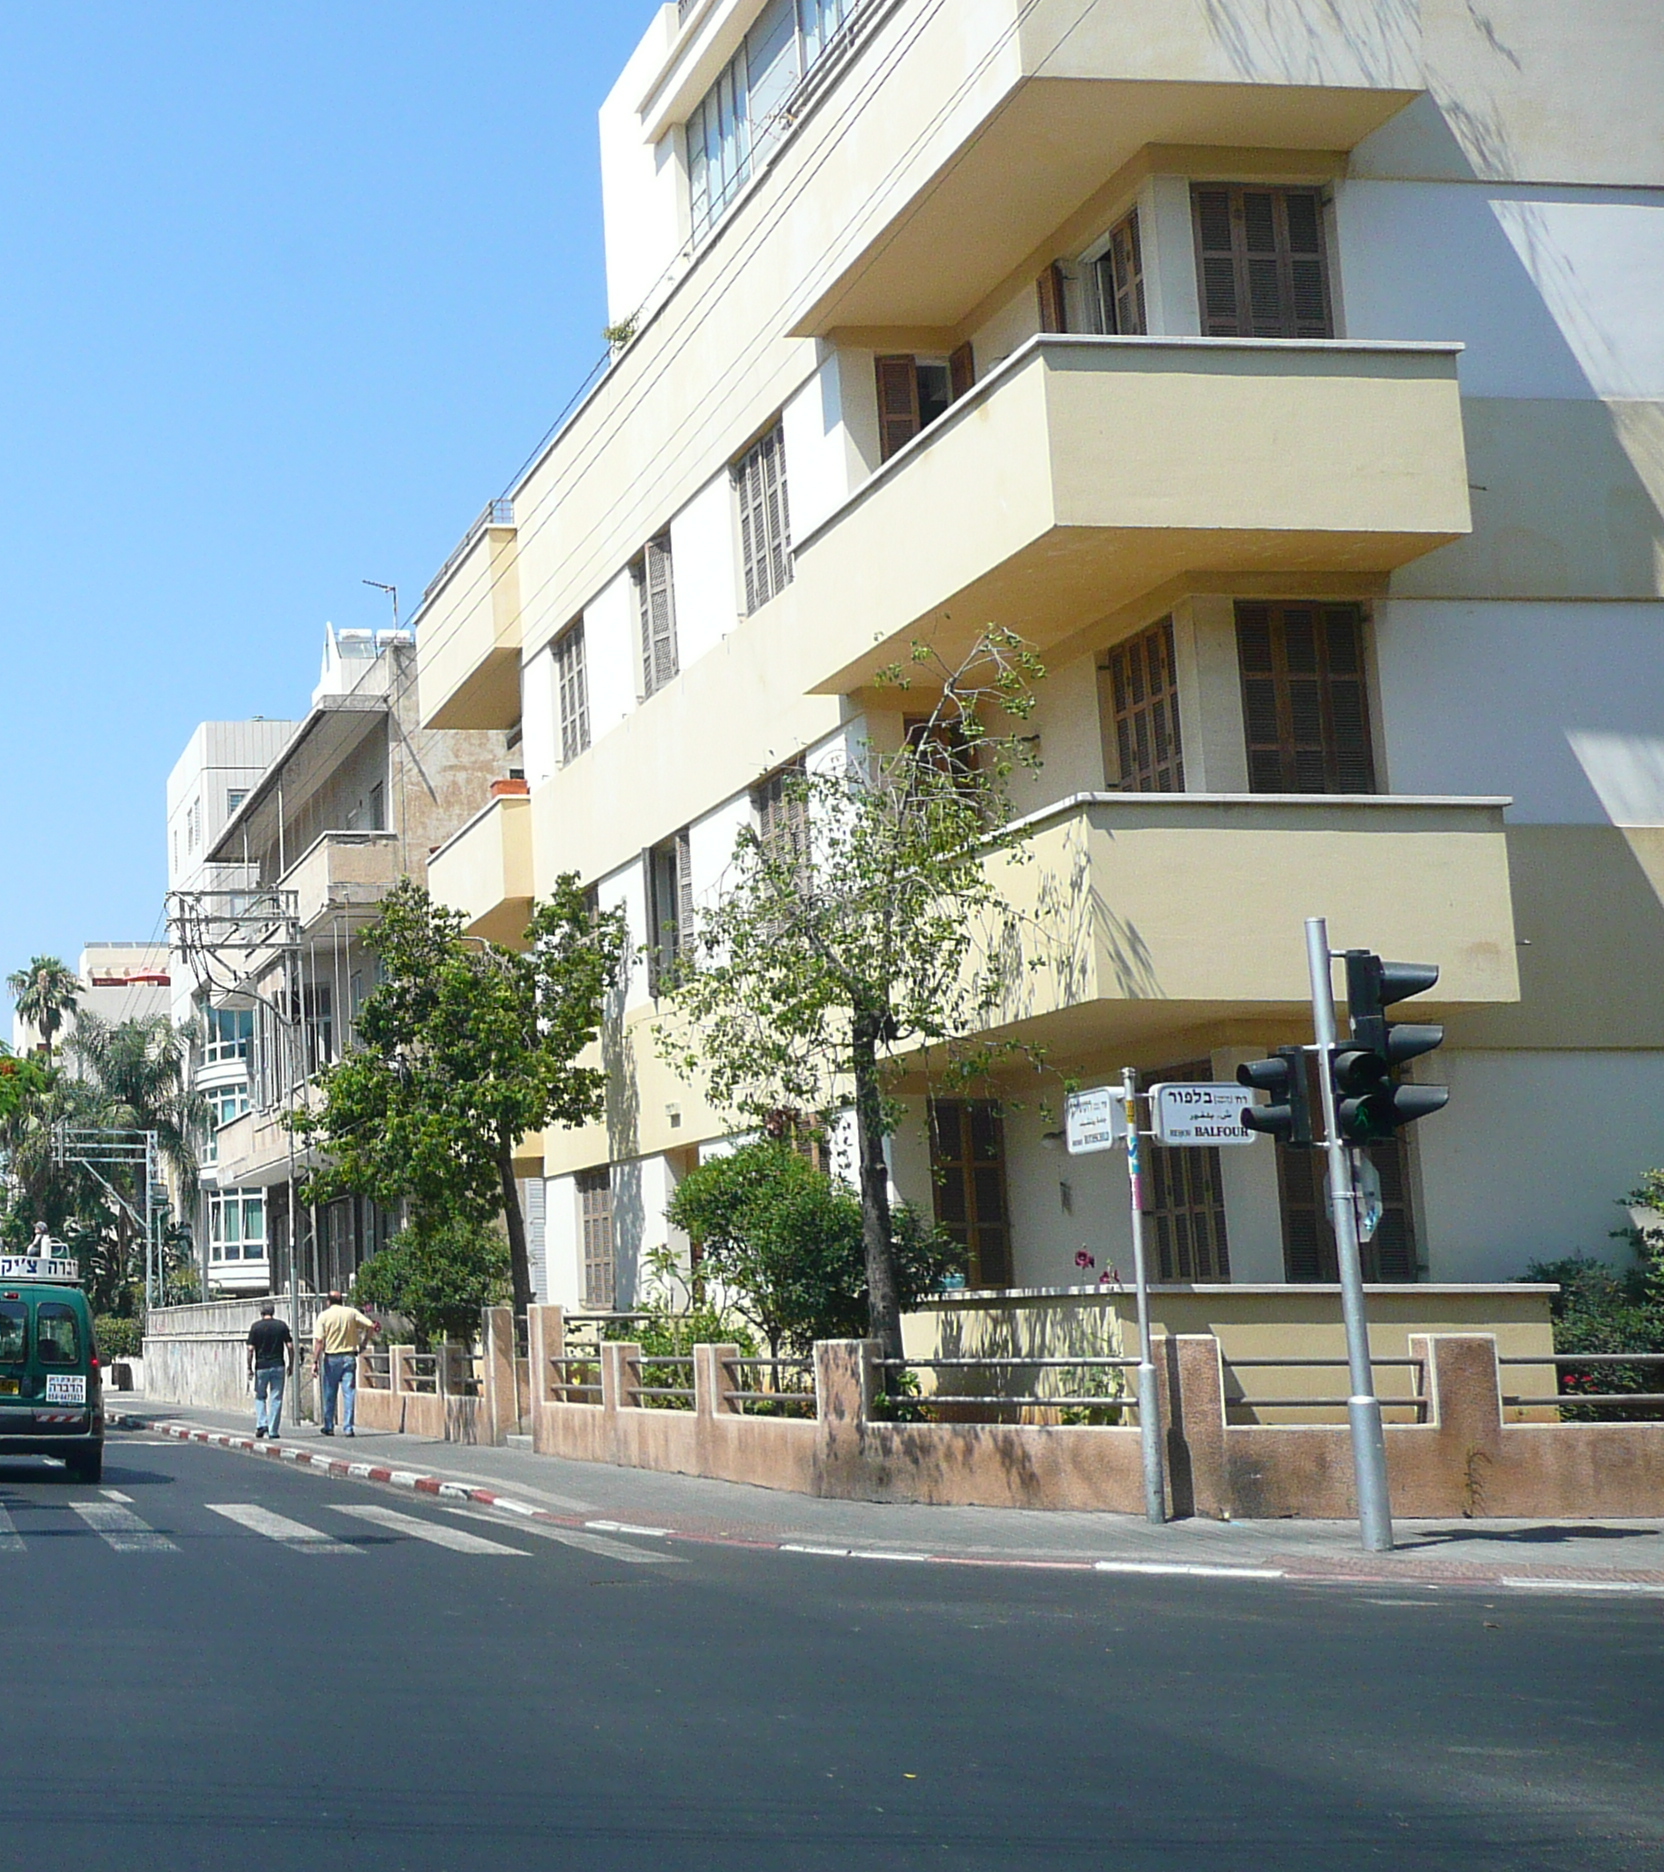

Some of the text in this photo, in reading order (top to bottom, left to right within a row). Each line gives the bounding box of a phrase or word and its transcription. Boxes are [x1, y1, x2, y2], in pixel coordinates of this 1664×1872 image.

[1168, 1088, 1213, 1104] בלפור
[1195, 1126, 1249, 1137] BALFOUR
[1, 1258, 38, 1276] צ'יק
[49, 1383, 83, 1393] הדברה
